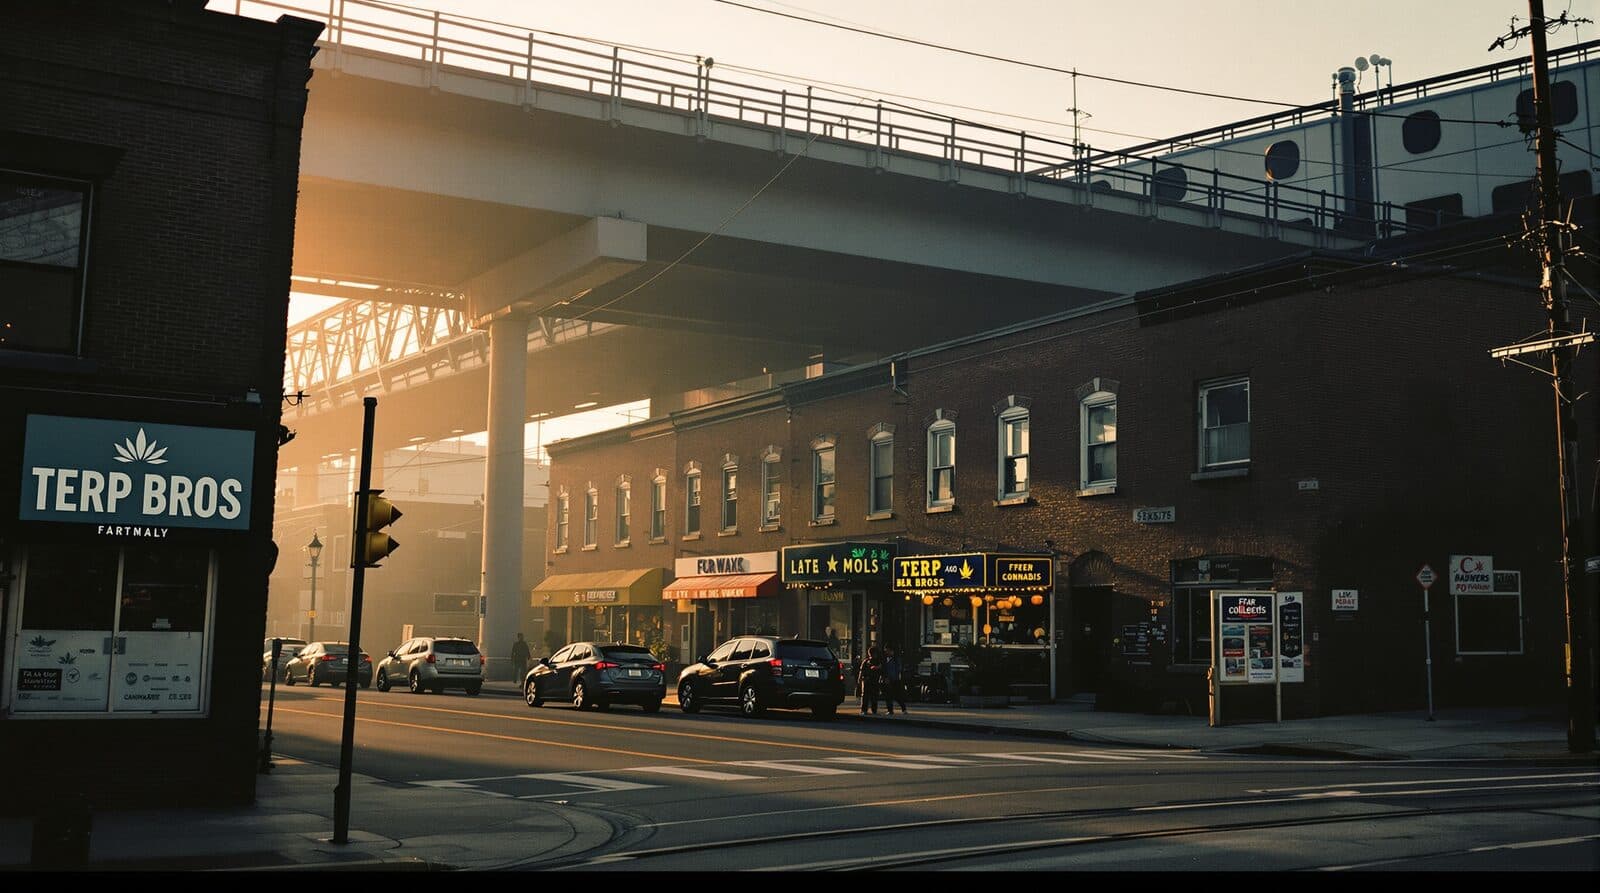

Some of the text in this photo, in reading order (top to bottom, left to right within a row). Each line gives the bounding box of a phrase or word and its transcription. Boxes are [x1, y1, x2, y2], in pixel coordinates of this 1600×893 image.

[32, 467, 242, 520] TERP BROS
[791, 558, 879, 575] LATE MOLS
[900, 560, 941, 577] TERP
